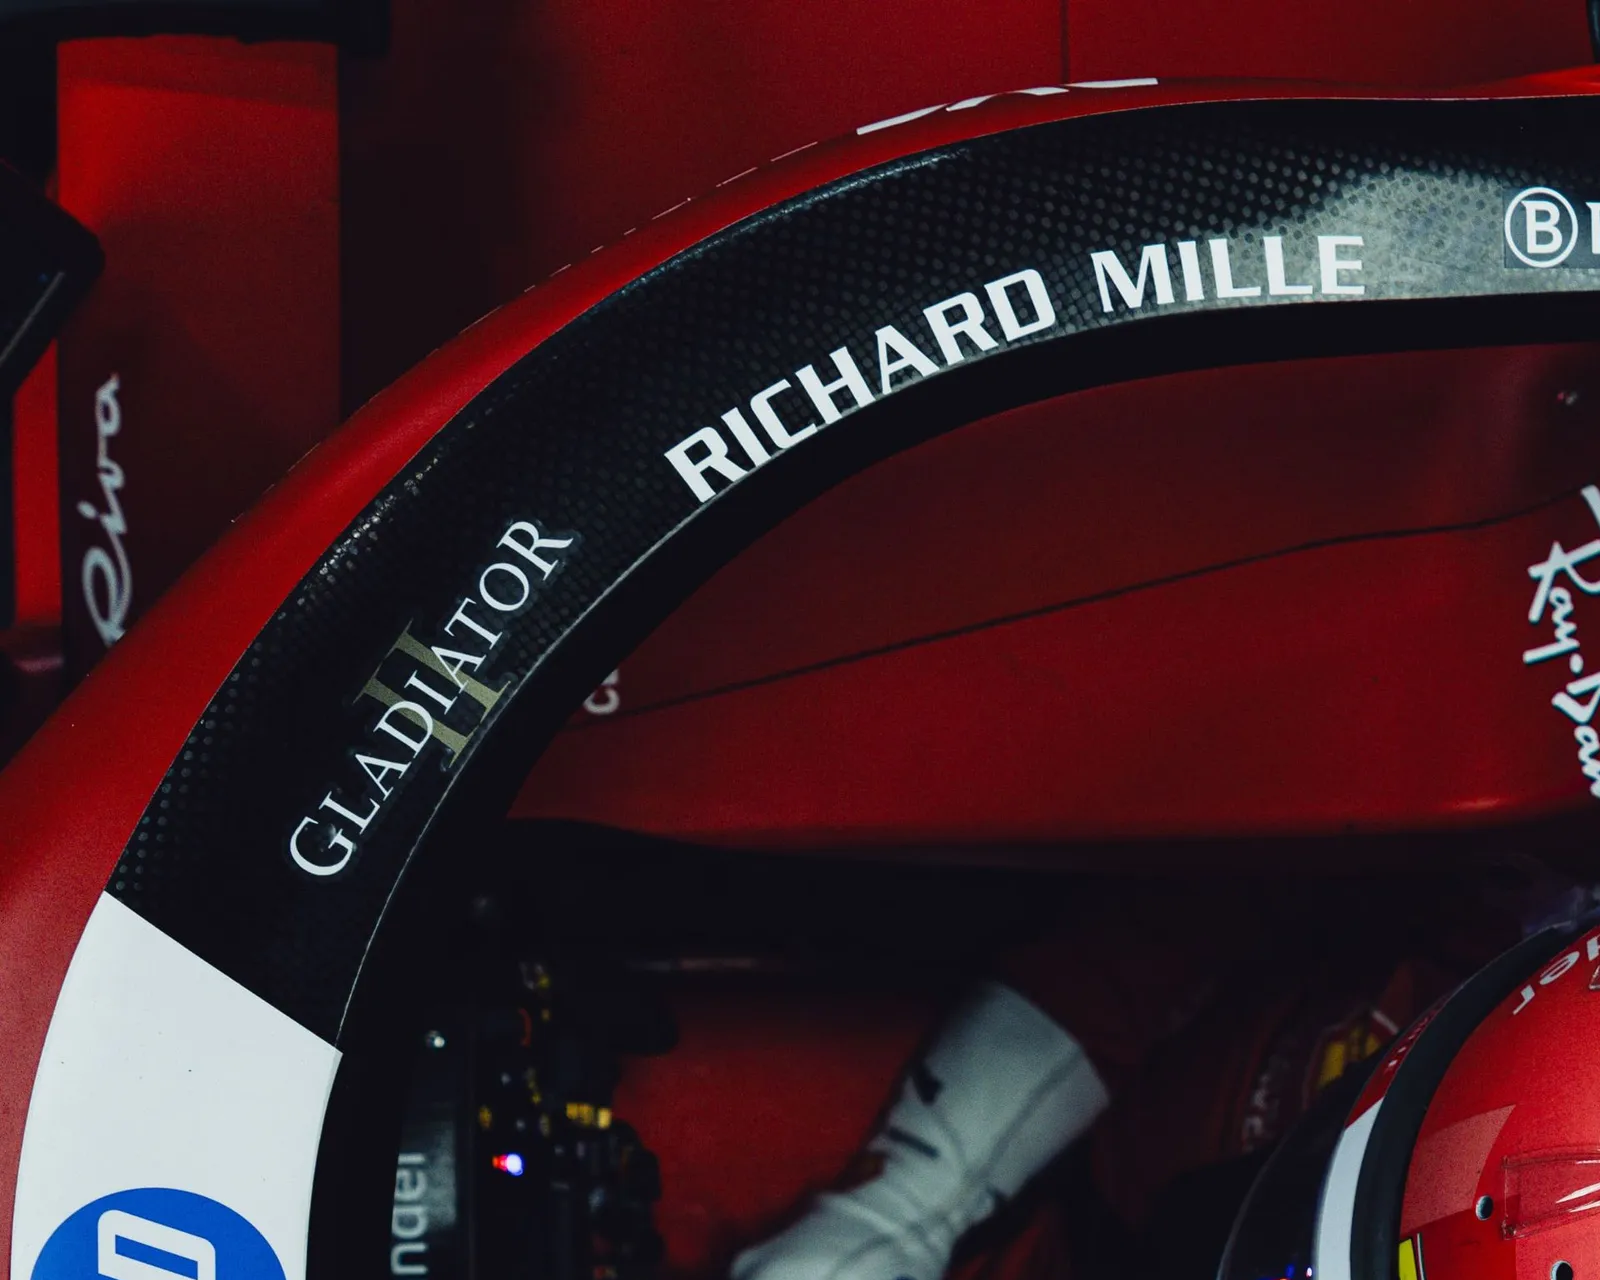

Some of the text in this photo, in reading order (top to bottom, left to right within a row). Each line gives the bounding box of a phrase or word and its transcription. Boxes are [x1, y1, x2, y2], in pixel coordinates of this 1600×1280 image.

[664, 236, 1365, 503] RICHARD MILLE
[290, 521, 574, 876] GLADIATOR
